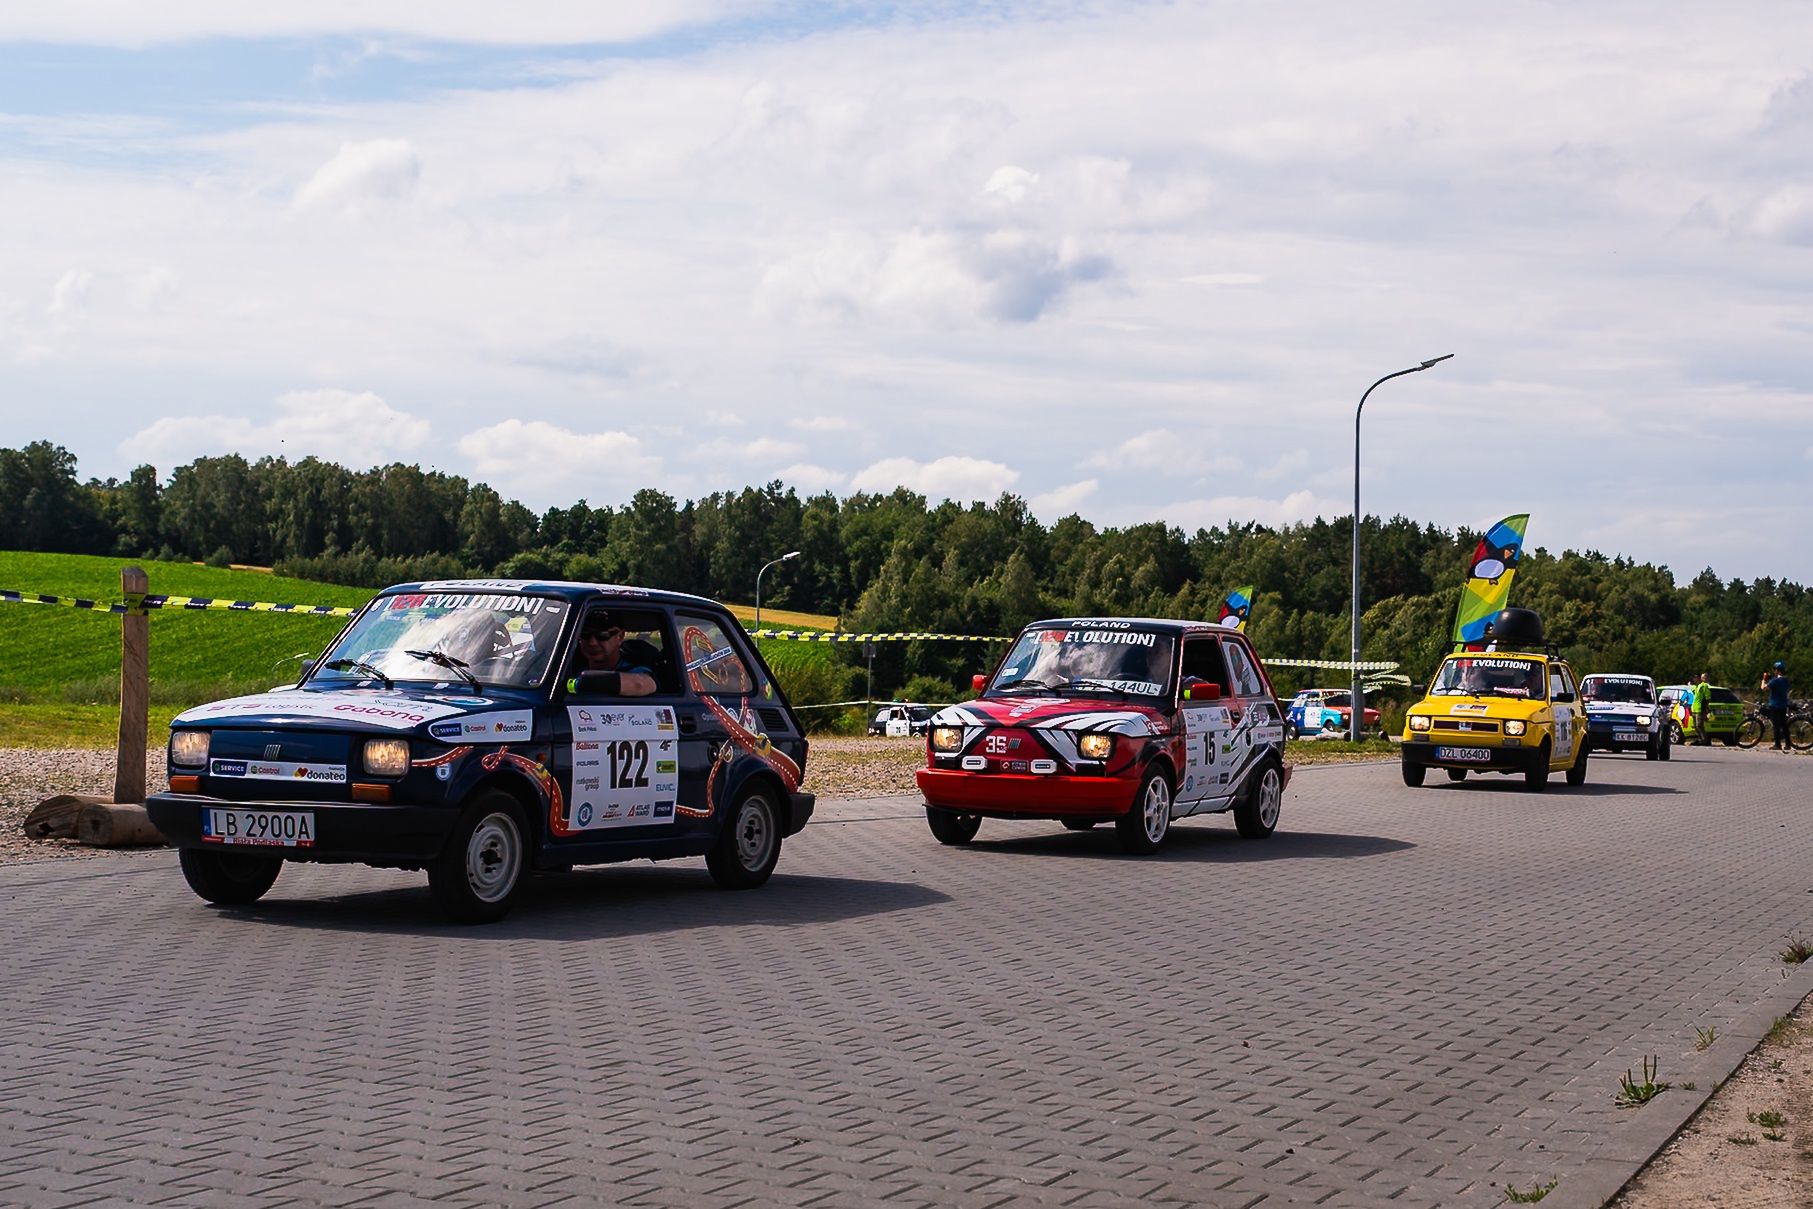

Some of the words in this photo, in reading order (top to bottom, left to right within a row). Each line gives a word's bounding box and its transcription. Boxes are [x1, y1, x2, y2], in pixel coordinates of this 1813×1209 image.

[1071, 620, 1131, 629] POLAND
[334, 703, 425, 723] Gabona
[985, 735, 1008, 754] 35
[1203, 731, 1216, 766] 15
[1440, 747, 1458, 758] DZL
[1460, 748, 1490, 760] 06400
[220, 763, 245, 773] SERVICE
[258, 766, 280, 775] Castrol
[606, 740, 649, 789] 122
[306, 769, 346, 781] donateo
[213, 811, 238, 837] LB
[245, 813, 311, 840] 2900A
